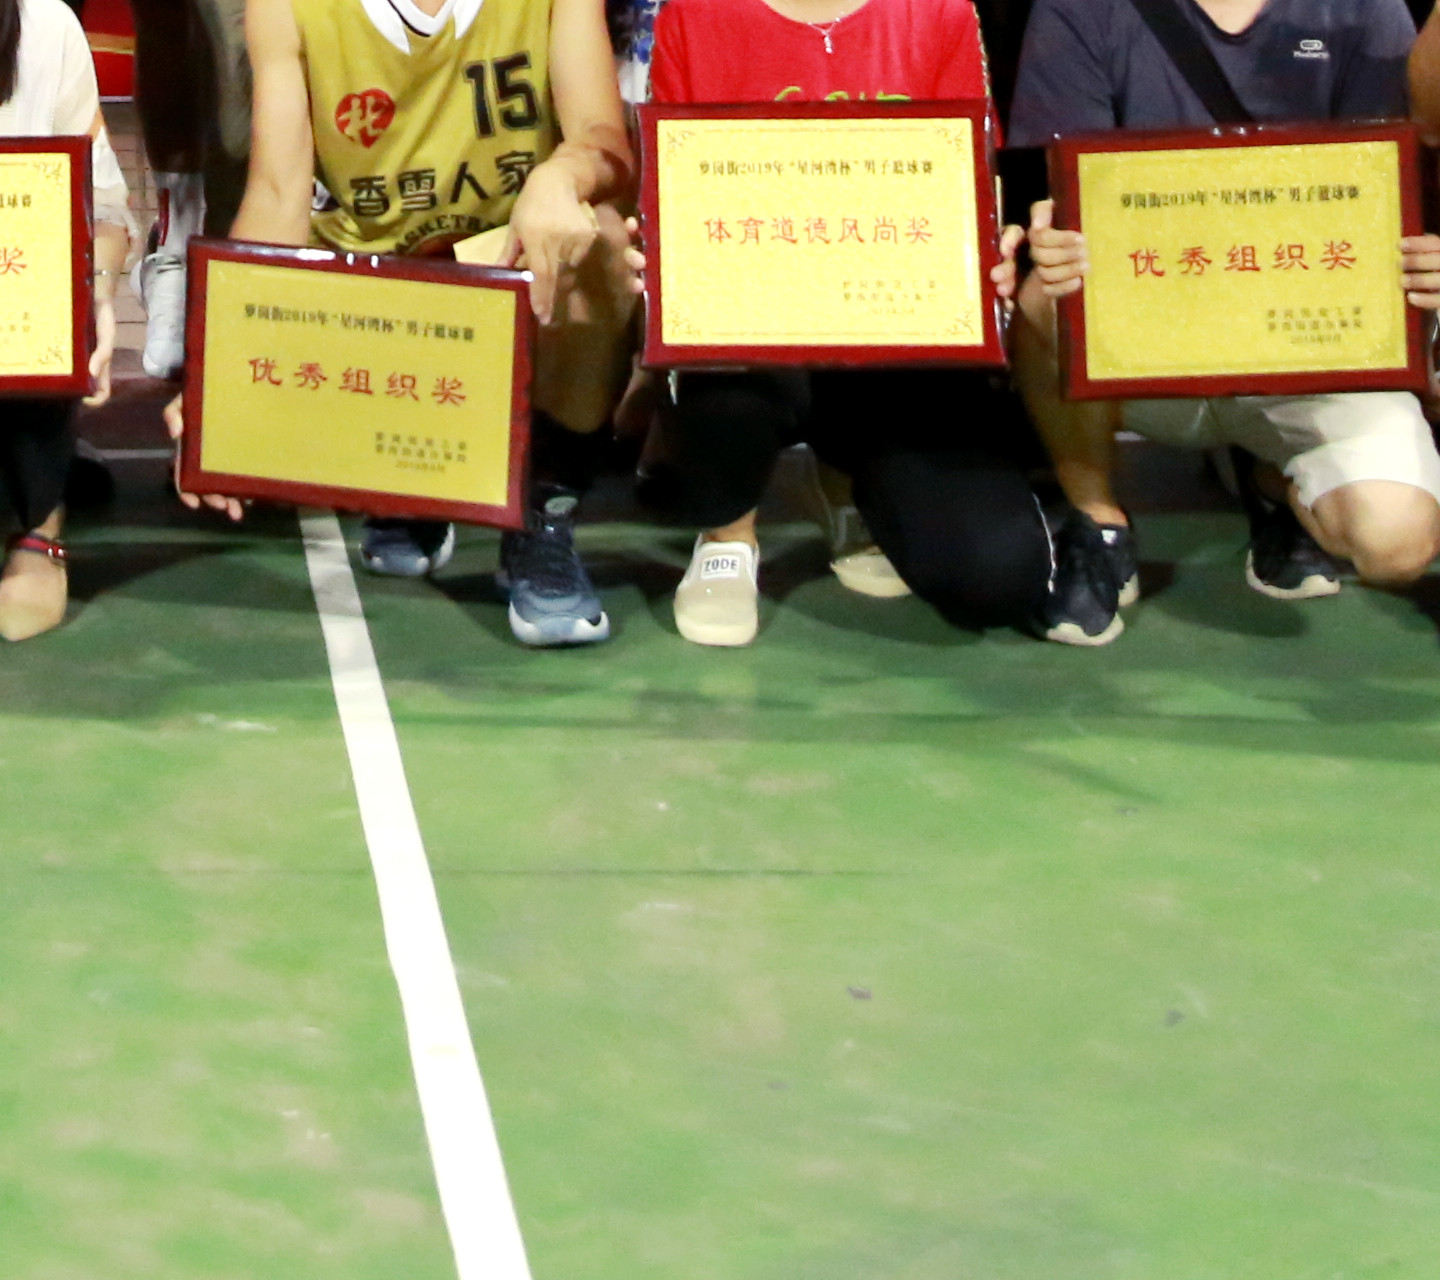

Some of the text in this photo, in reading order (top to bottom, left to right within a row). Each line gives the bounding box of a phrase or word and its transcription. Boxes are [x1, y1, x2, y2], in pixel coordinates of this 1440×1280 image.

[463, 50, 542, 140] 15
[704, 215, 934, 245] 体育道德风尚奖
[1128, 239, 1358, 279] 优秀组织奖
[248, 356, 468, 408] 优秀组织奖
